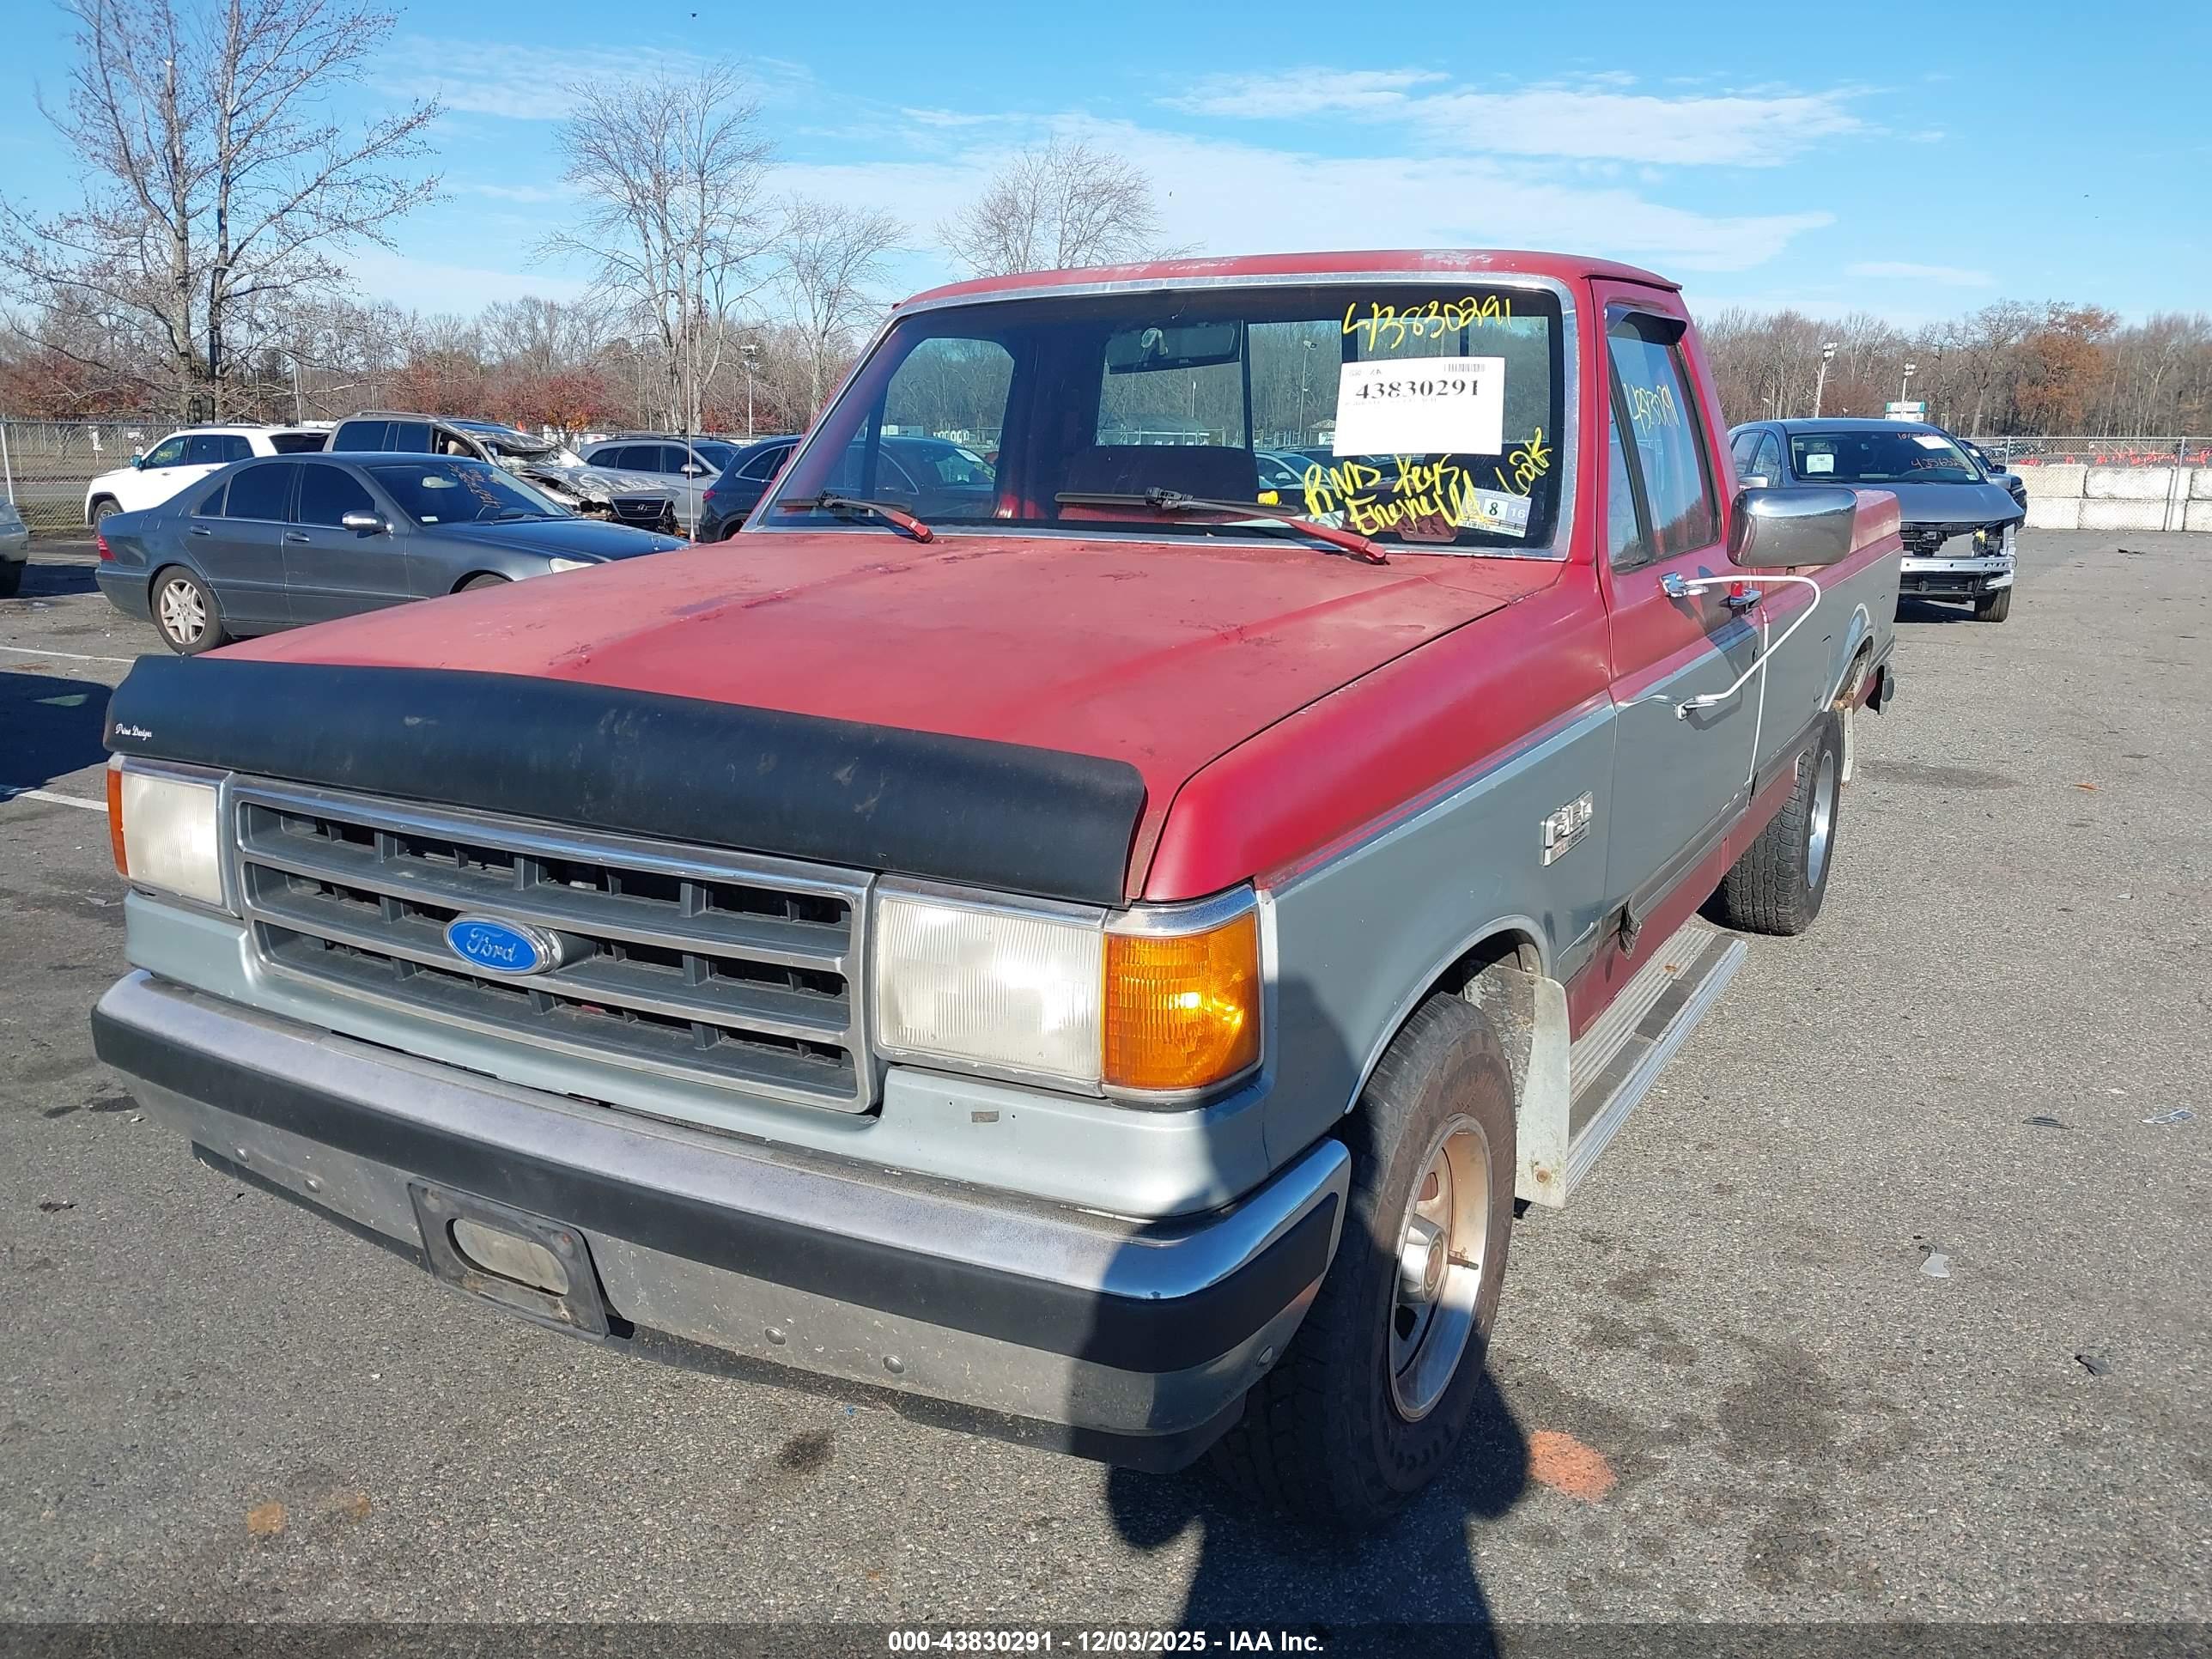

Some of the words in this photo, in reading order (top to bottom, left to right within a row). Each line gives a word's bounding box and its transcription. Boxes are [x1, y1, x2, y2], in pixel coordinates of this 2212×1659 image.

[1342, 295, 1512, 352] 43830291
[1356, 379, 1479, 399] 43830291
[1489, 501, 1498, 516] 8
[1511, 508, 1526, 519] 16
[466, 927, 516, 962] Ford
